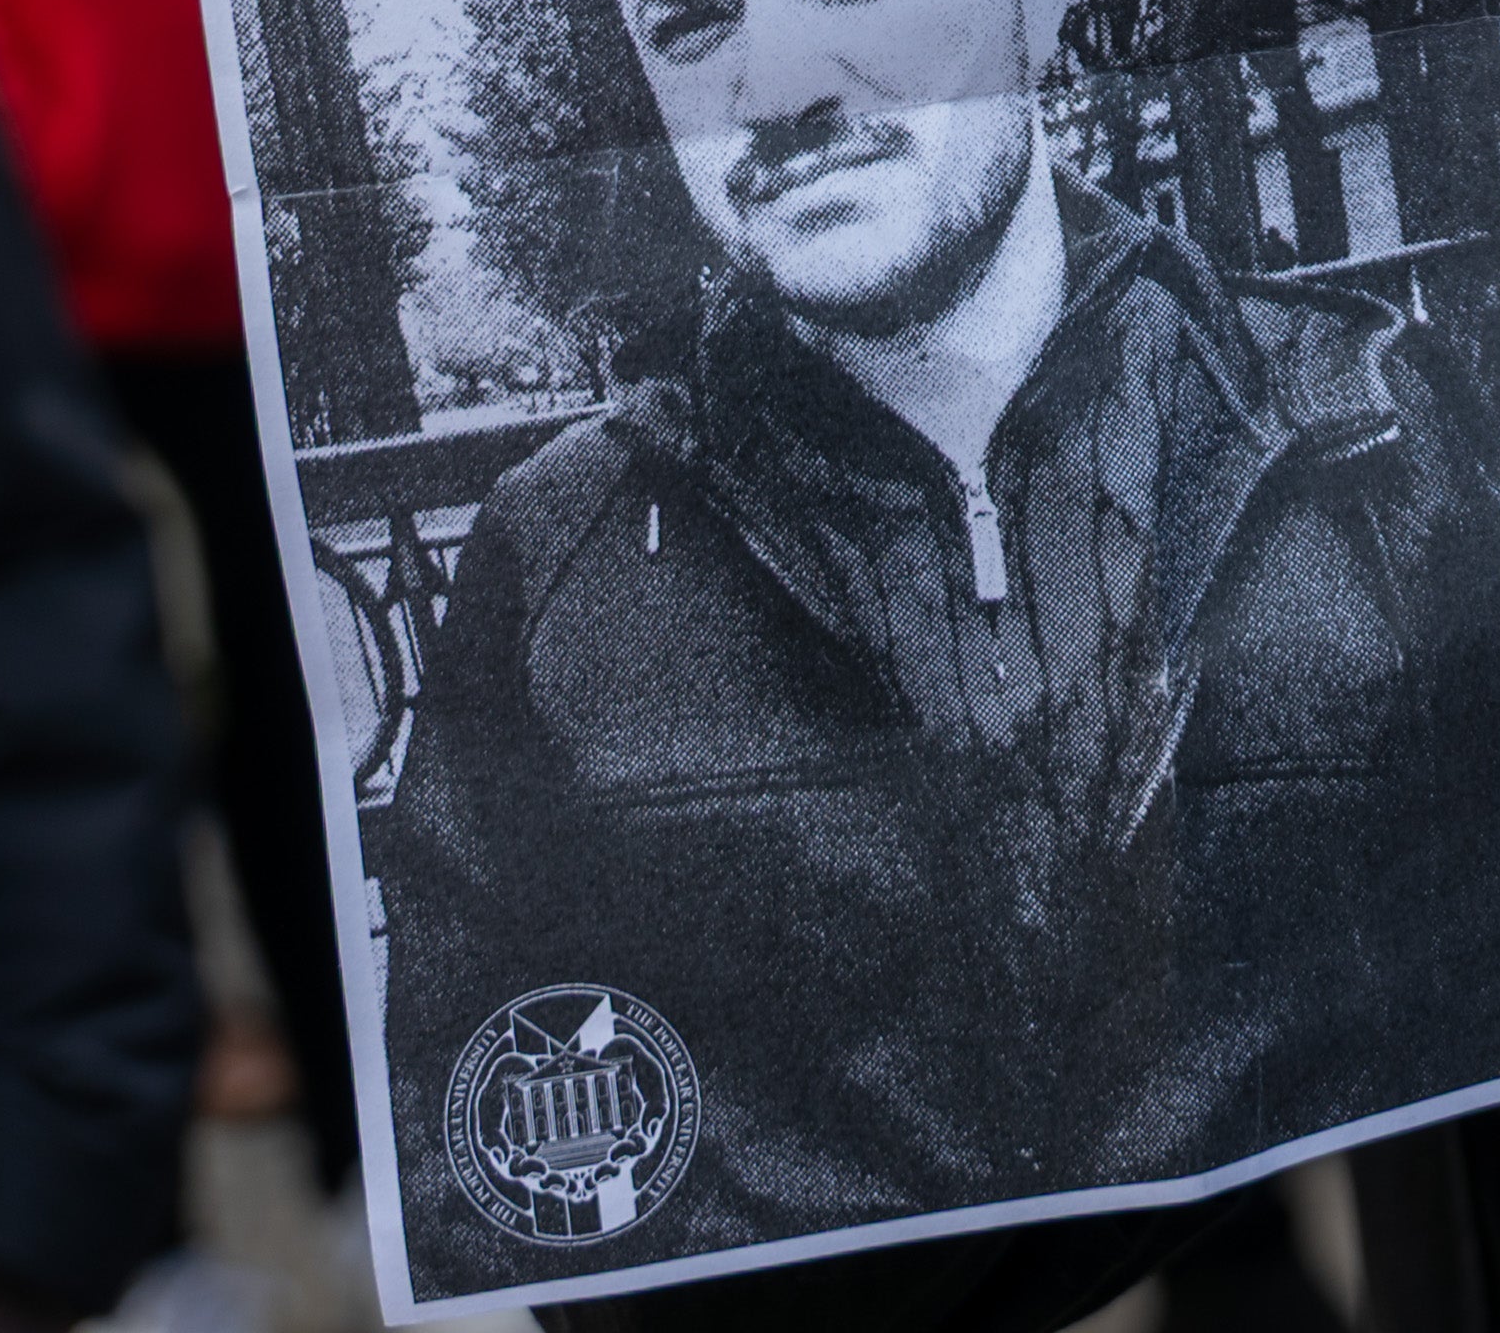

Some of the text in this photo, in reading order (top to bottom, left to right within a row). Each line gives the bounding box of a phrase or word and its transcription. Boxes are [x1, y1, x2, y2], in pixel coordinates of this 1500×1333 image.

[451, 1025, 498, 1125] UNIVERSITY
[625, 1000, 696, 1198] THE POPULAR UNIVERSITY
